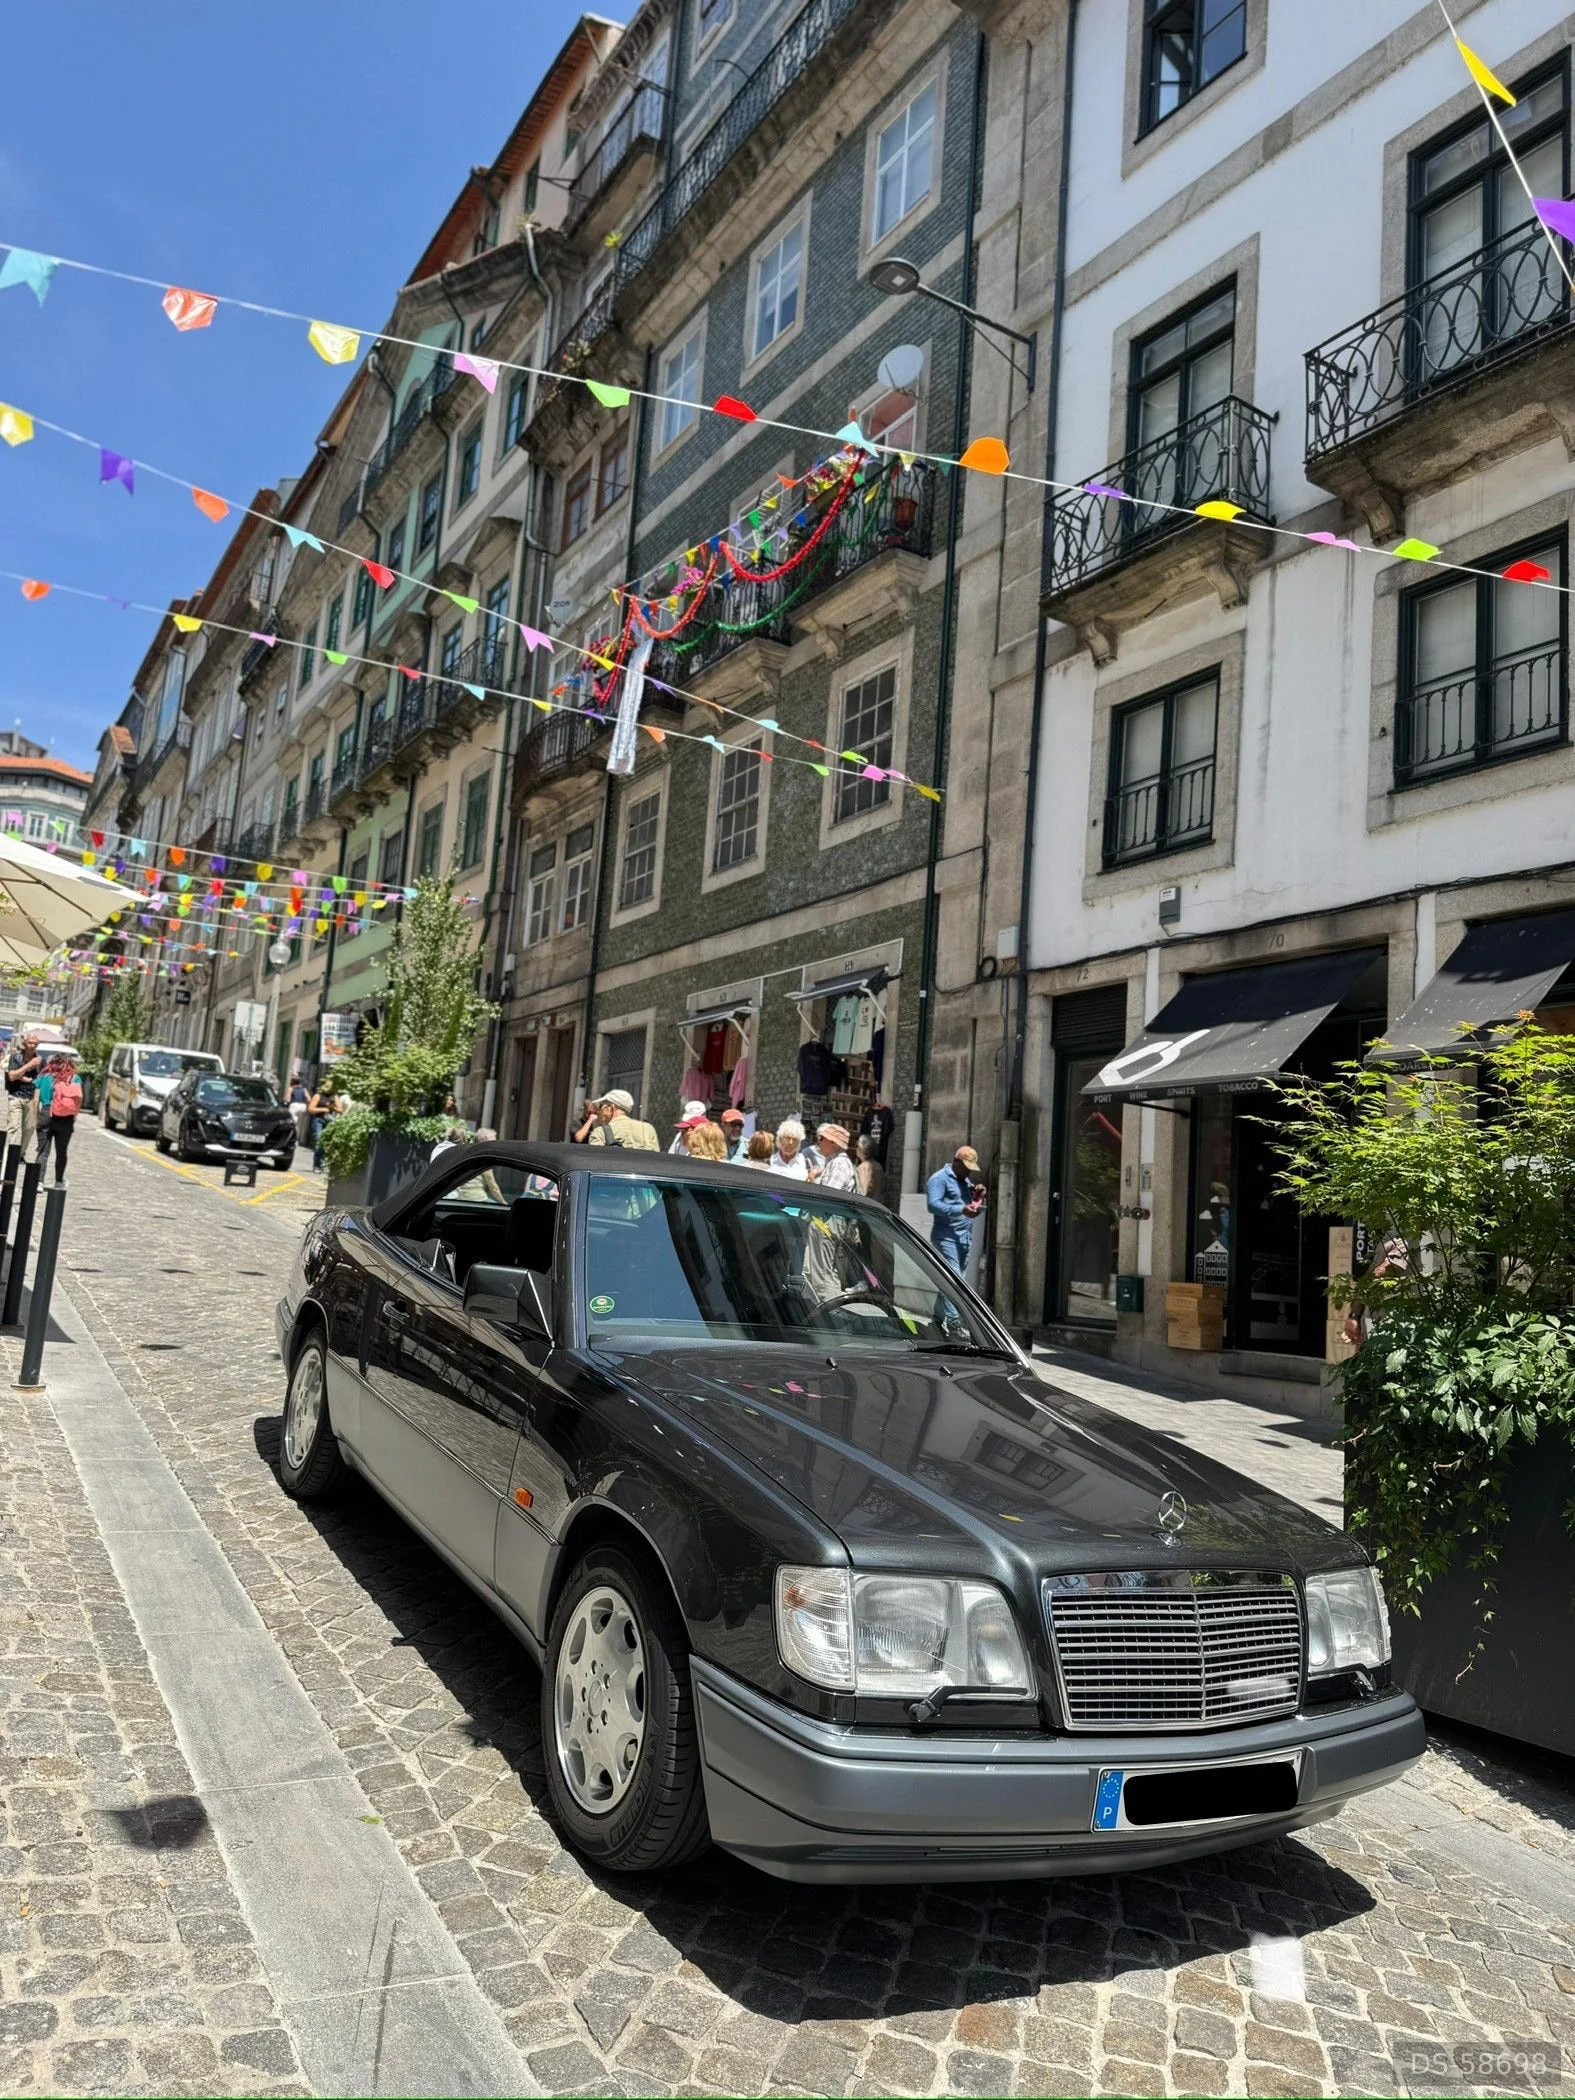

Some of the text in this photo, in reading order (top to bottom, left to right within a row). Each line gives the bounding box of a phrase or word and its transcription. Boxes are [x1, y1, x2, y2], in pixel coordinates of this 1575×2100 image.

[1093, 1094, 1112, 1103] PORT
[1129, 1091, 1148, 1100] WINE
[1218, 1081, 1259, 1093] TOBACCO
[1367, 1230, 1376, 1254] TAS
[1103, 1806, 1113, 1820] P
